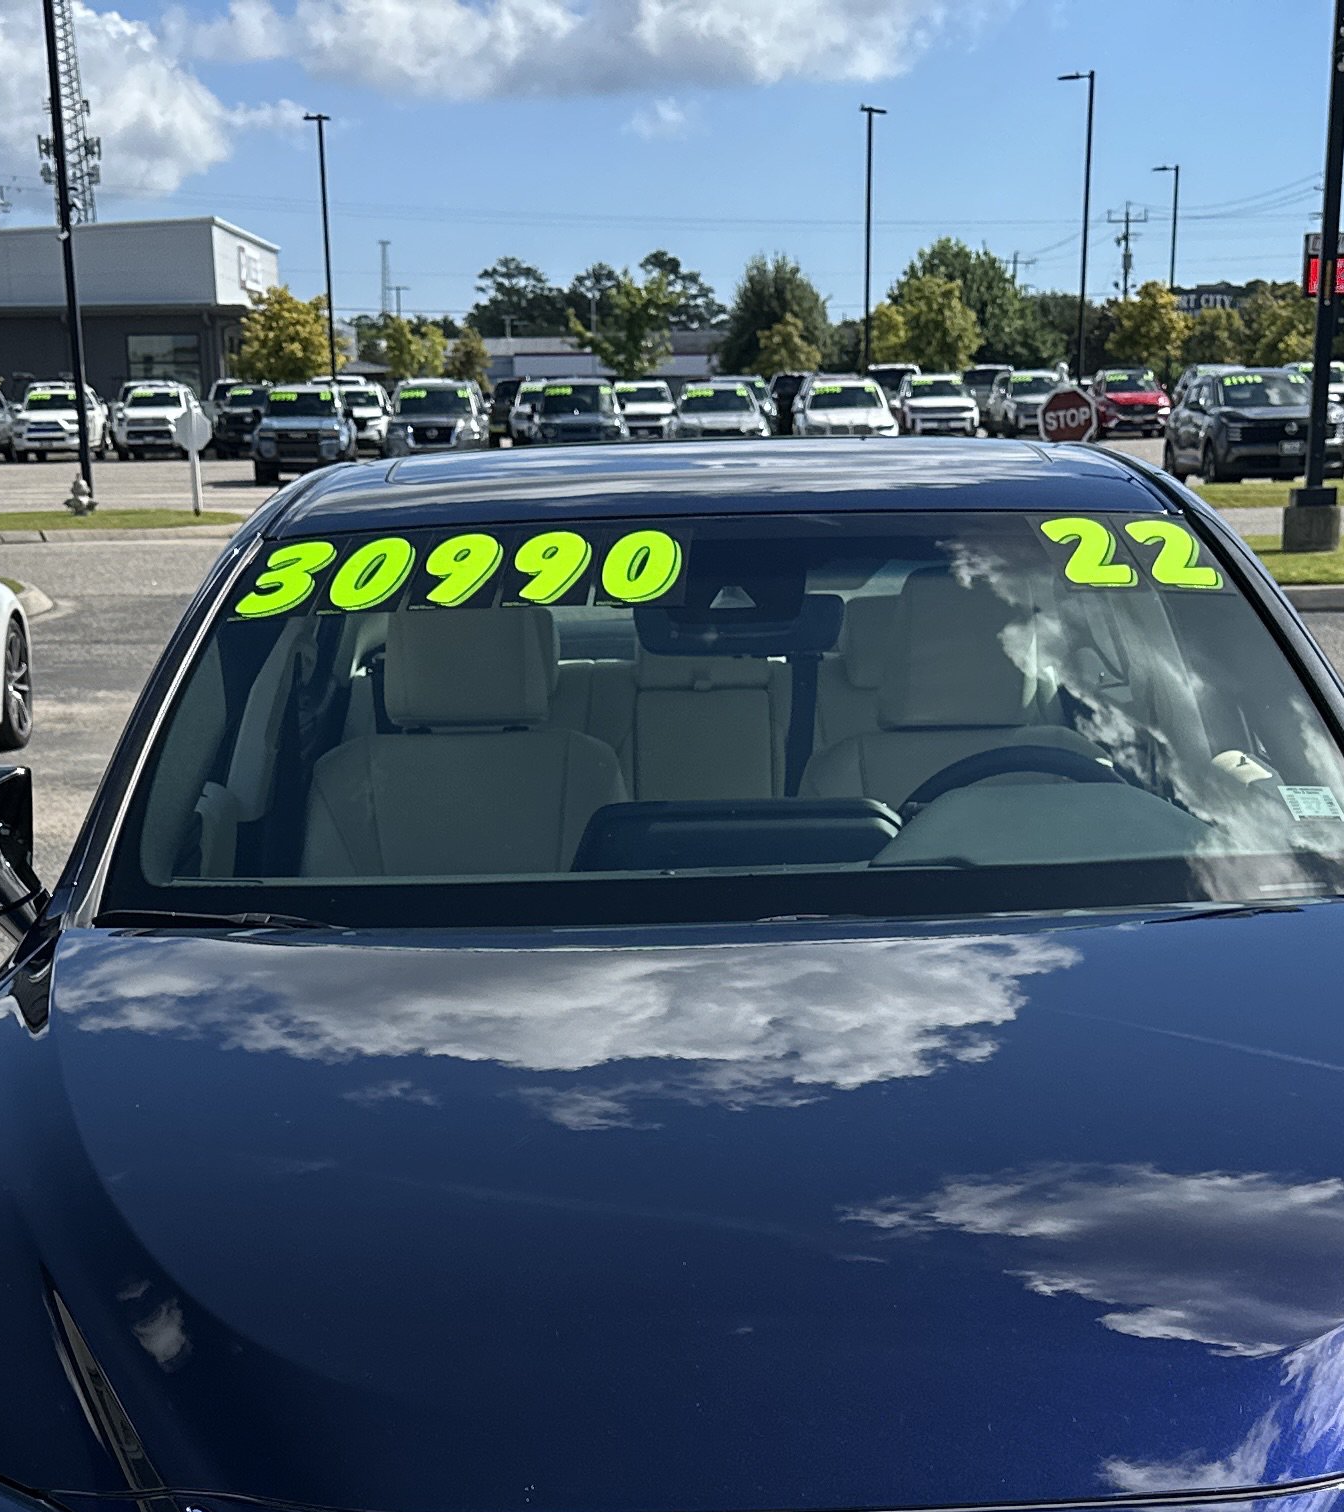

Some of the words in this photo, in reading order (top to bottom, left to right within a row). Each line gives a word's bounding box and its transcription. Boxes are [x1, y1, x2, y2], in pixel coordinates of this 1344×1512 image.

[1044, 407, 1091, 431] STOP
[235, 530, 682, 617] 30990
[1040, 517, 1224, 590] 22
